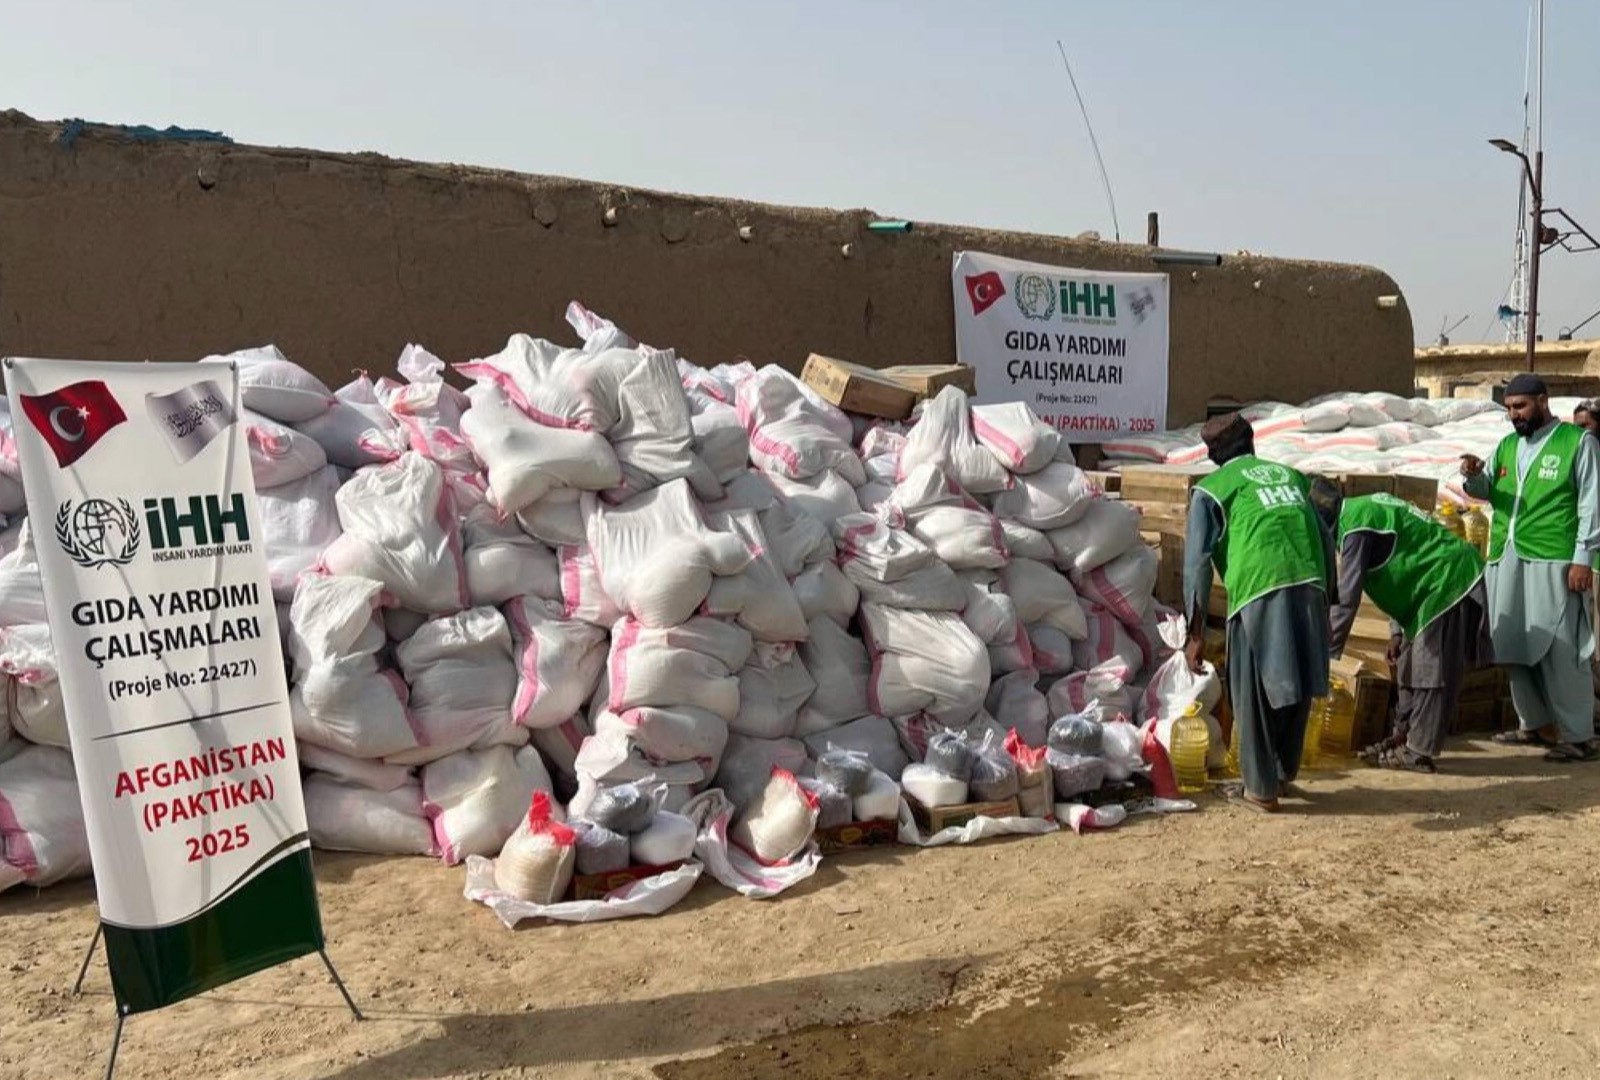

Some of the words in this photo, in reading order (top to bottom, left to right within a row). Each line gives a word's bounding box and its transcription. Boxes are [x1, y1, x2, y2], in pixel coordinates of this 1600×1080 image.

[1005, 330, 1050, 351] GIDA
[1054, 333, 1126, 357] YARDIMI
[1006, 360, 1123, 386] ÇALIŞMALARI
[1129, 417, 1155, 432] 2025
[186, 545, 225, 559] YARDIM
[225, 543, 253, 556] VAKFI
[71, 598, 145, 627] GIDA
[150, 582, 260, 618] YARDIMI
[84, 616, 261, 669] ÇALIŞMALARI
[109, 676, 162, 701] (Proje
[165, 670, 196, 689] No:
[200, 658, 257, 684] 22427)
[115, 737, 287, 798] AFGANİSTAN
[143, 775, 275, 832] (PAKTİKA)
[185, 824, 250, 862] 2025
